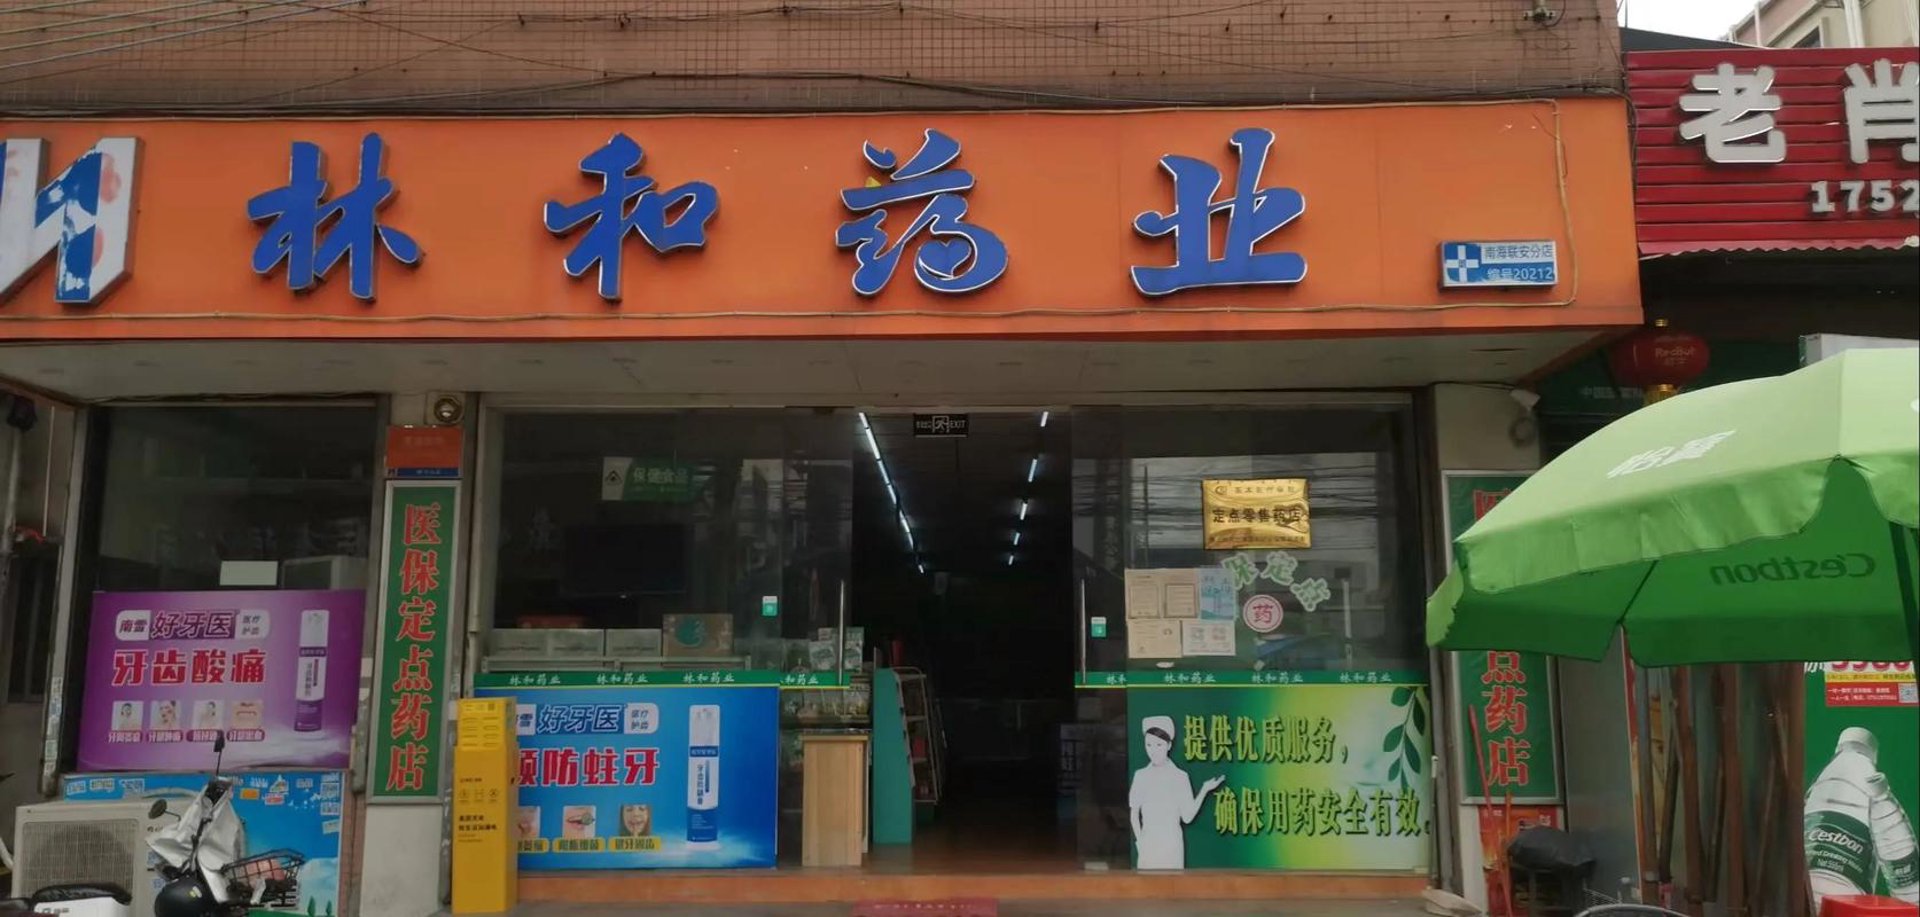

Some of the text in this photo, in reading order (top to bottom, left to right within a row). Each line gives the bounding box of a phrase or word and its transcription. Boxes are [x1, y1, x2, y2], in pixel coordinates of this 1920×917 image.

[1679, 58, 1918, 164] 老肖
[1811, 180, 1919, 213] 1752
[247, 127, 1308, 302] 林和药业
[1484, 244, 1553, 260] 南海联安分店
[1487, 266, 1553, 281] 编号20212
[1212, 506, 1300, 523] 定点零售药店
[151, 610, 233, 639] 好牙医
[386, 502, 441, 791] 医保定点药店
[111, 647, 267, 687] 牙齿酸痛
[509, 672, 561, 686] 林和药业
[596, 671, 649, 685] 林和药业
[682, 671, 735, 685] 林和药业
[780, 673, 819, 686] 和药业
[1164, 671, 1217, 685] 林和药业
[1251, 671, 1304, 685] 林和药业
[1339, 671, 1392, 684] 林和药业
[516, 703, 622, 734] 雪 好牙医
[1480, 650, 1531, 787] 点药店
